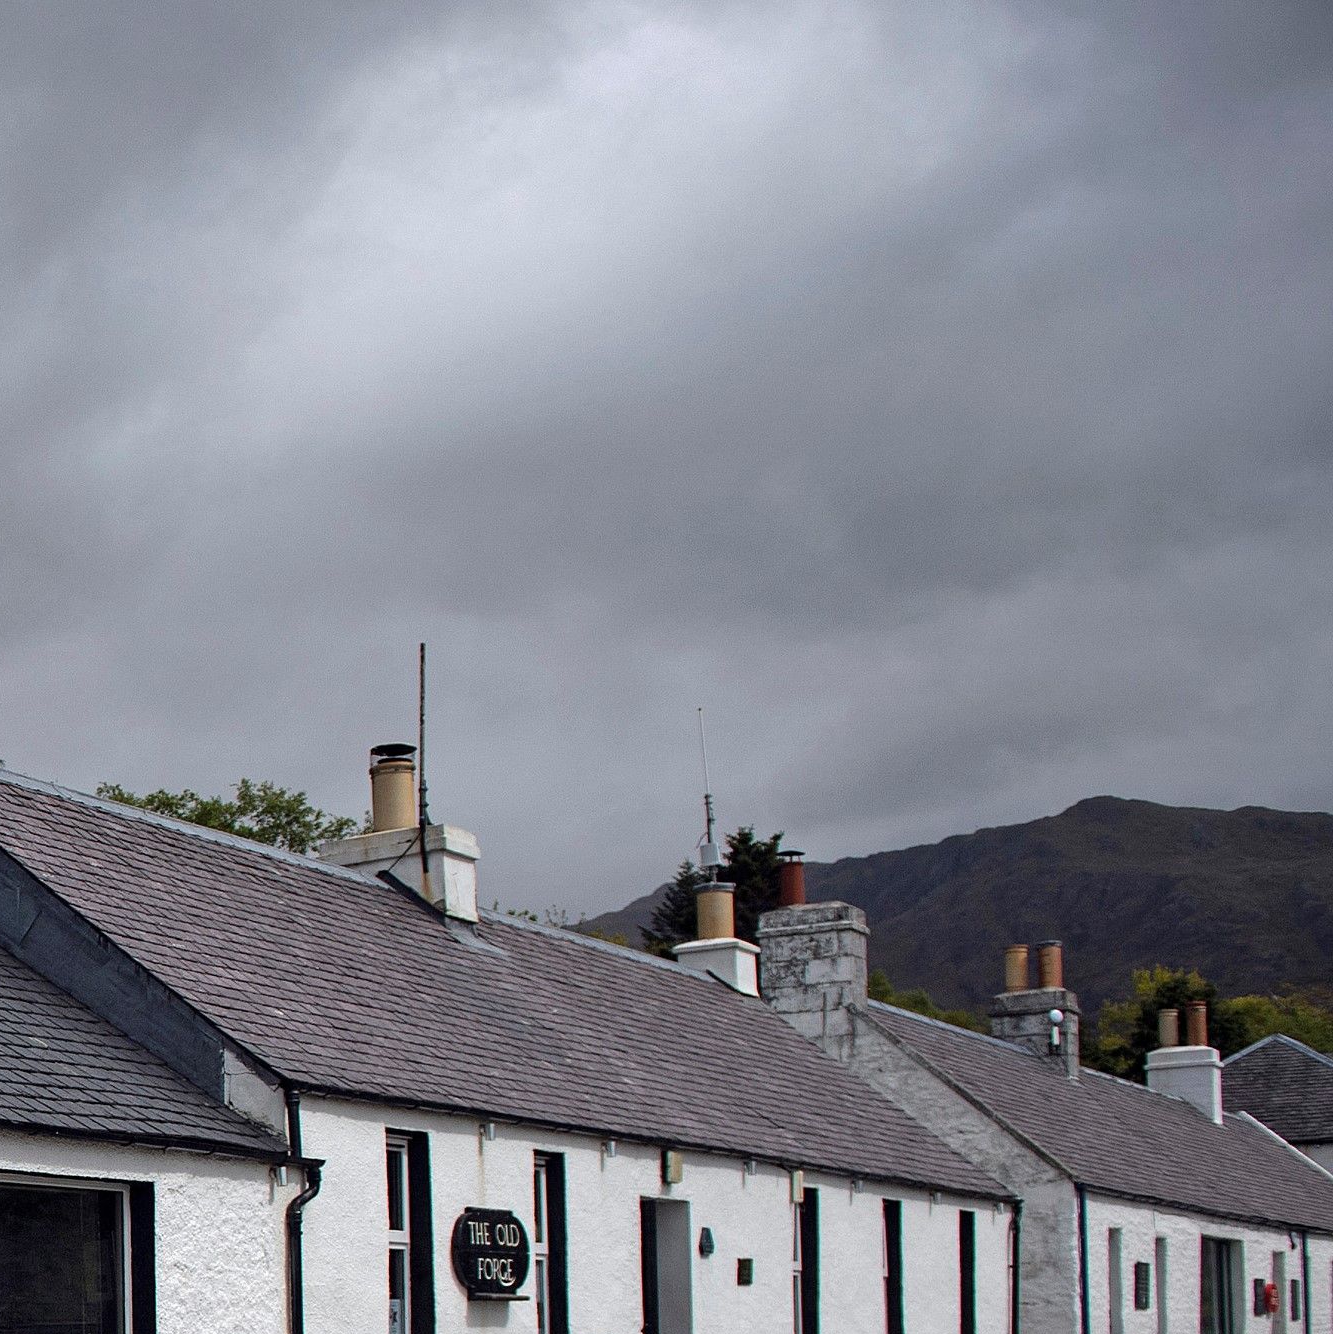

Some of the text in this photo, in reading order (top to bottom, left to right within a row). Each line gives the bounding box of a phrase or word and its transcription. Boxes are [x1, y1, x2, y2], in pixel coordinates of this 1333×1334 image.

[468, 1222, 519, 1246] THE OLD
[478, 1258, 516, 1286] FORGE
